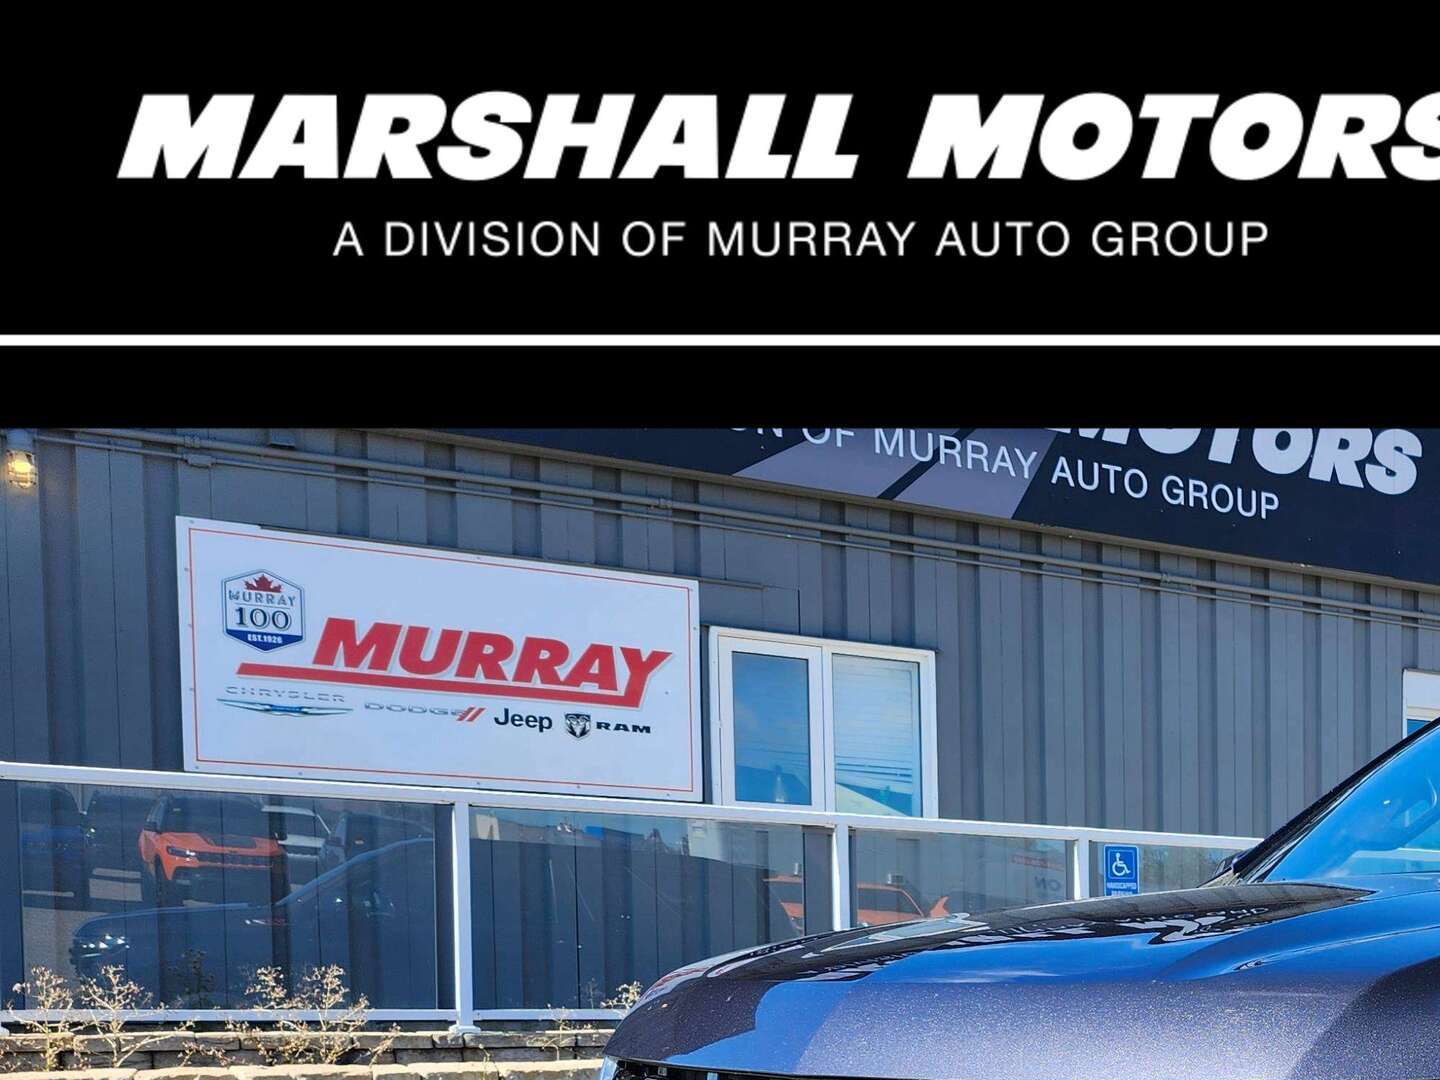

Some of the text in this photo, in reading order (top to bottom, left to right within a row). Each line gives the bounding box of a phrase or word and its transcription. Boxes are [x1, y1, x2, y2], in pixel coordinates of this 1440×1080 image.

[874, 429, 1037, 479] MURRAY
[1051, 455, 1148, 499] AUTO
[1161, 475, 1280, 520] GROUP
[1045, 428, 1422, 495] ORS
[228, 590, 296, 606] MURRAY
[235, 607, 292, 631] 100
[312, 616, 673, 695] MURRAY
[494, 707, 553, 733] Jeep
[596, 721, 651, 734] RAM
